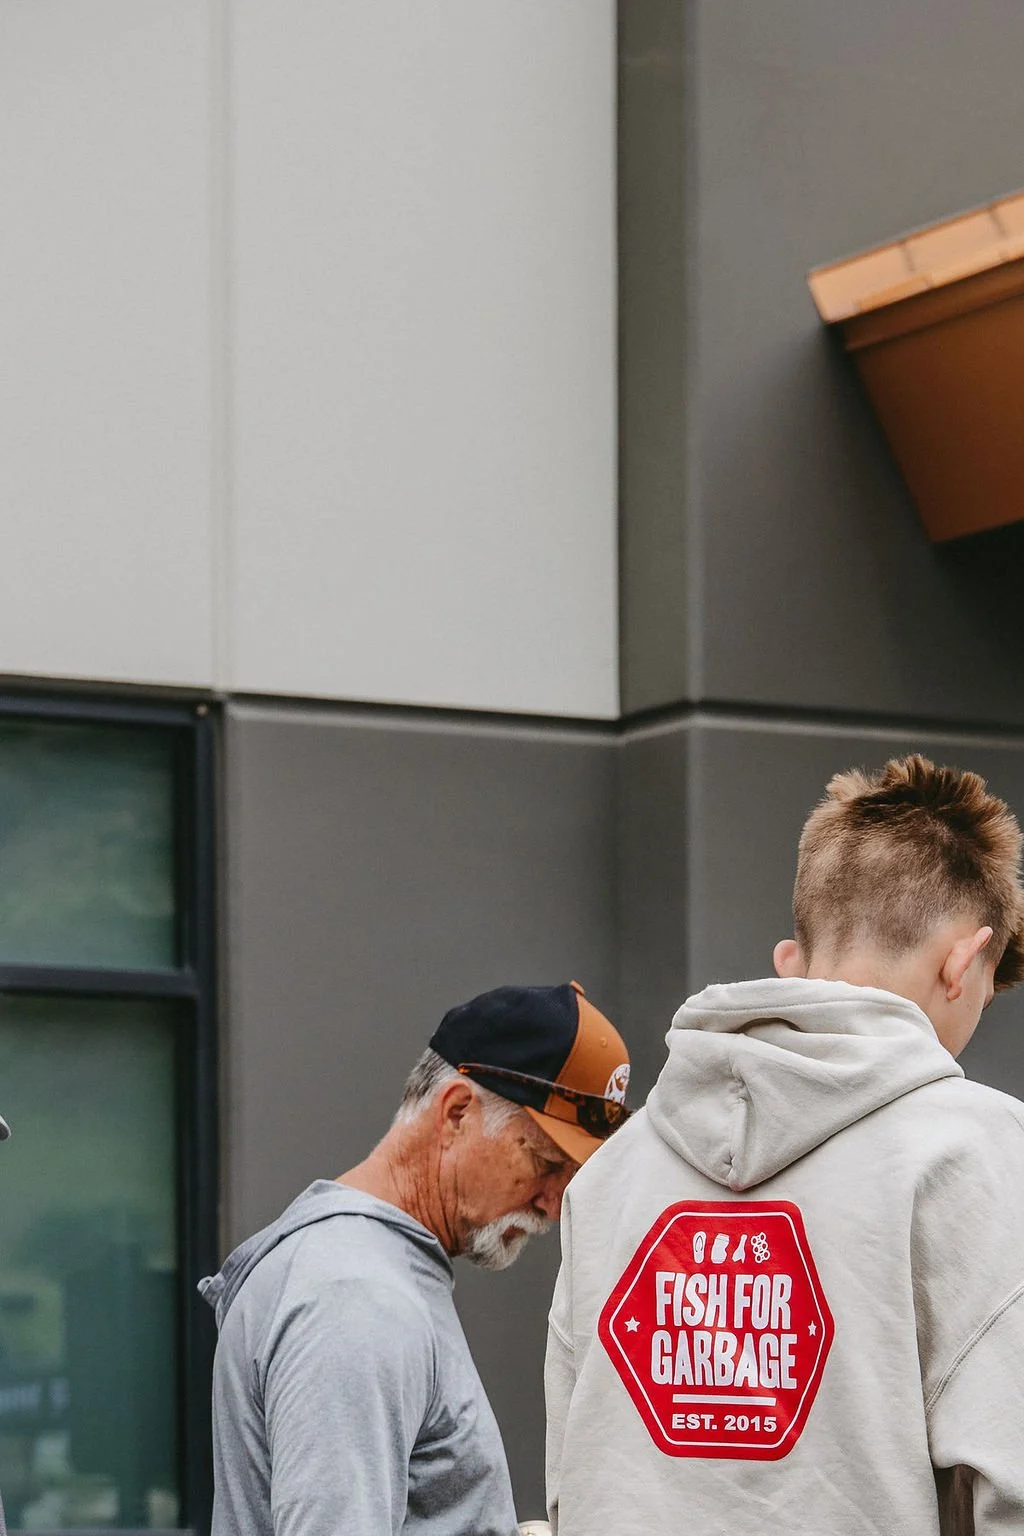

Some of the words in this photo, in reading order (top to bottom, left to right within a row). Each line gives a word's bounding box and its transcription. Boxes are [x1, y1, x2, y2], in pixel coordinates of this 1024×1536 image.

[655, 1271, 728, 1328] FISH
[734, 1274, 793, 1330] FOR
[651, 1330, 798, 1389] GARBAGE
[672, 1413, 718, 1430] EST.
[724, 1415, 777, 1432] 2015
